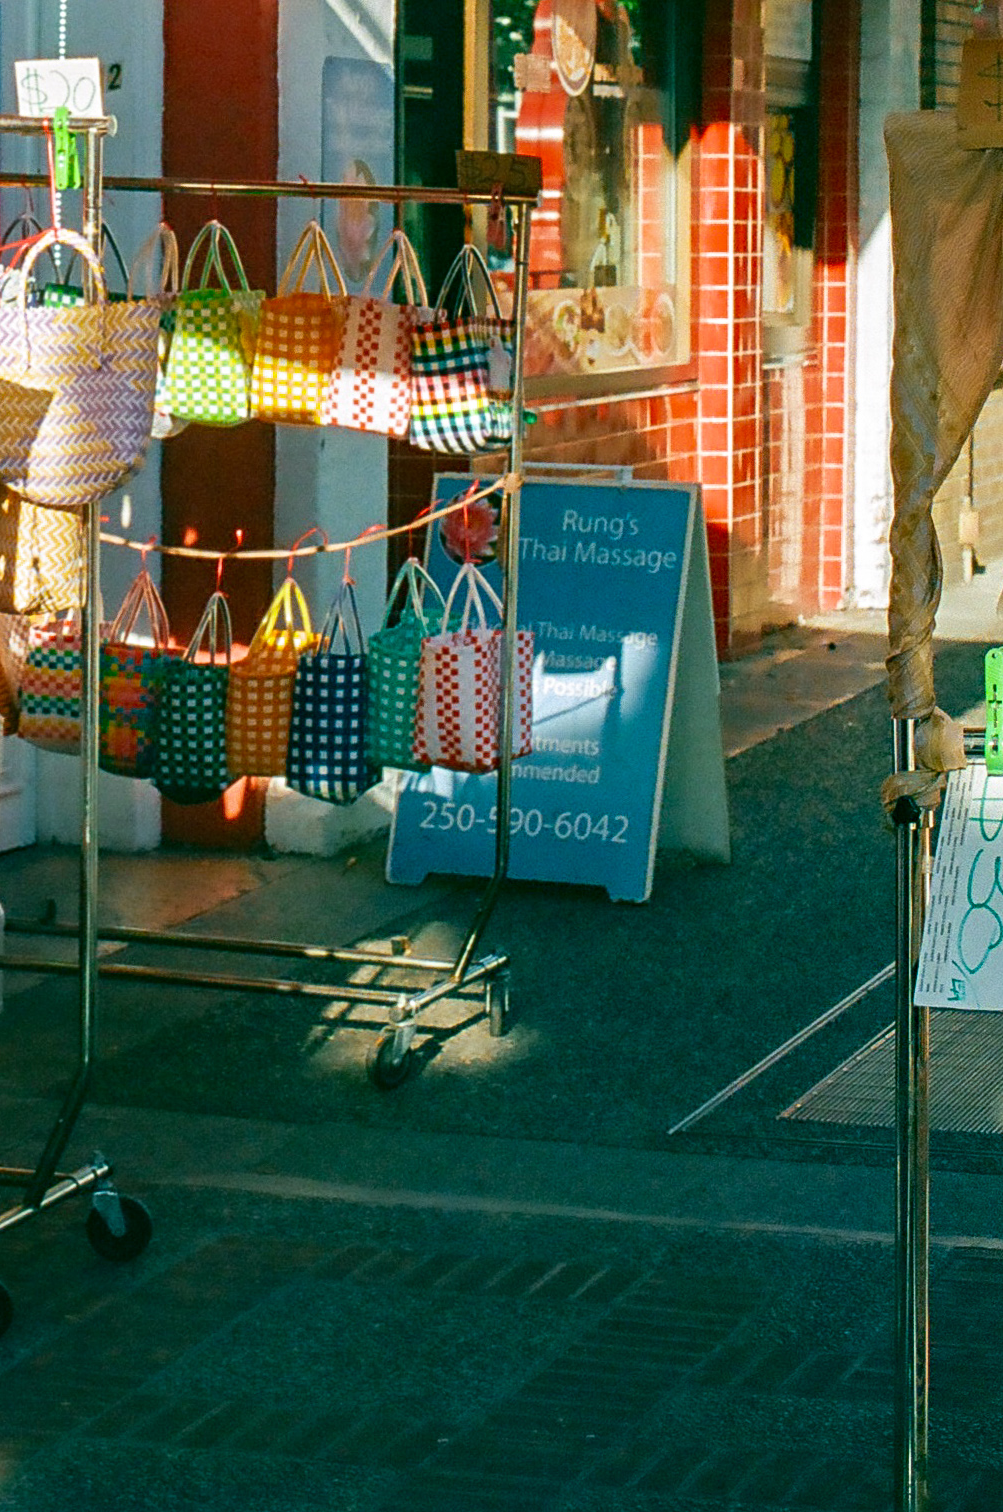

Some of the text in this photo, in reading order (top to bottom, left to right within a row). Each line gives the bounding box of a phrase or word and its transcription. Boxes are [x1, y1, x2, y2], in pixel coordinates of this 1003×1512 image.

[561, 508, 640, 541] Rung's
[519, 537, 677, 574] Thai Massage
[538, 621, 573, 639] Thai
[579, 624, 658, 649] Massage
[534, 736, 598, 756] tments
